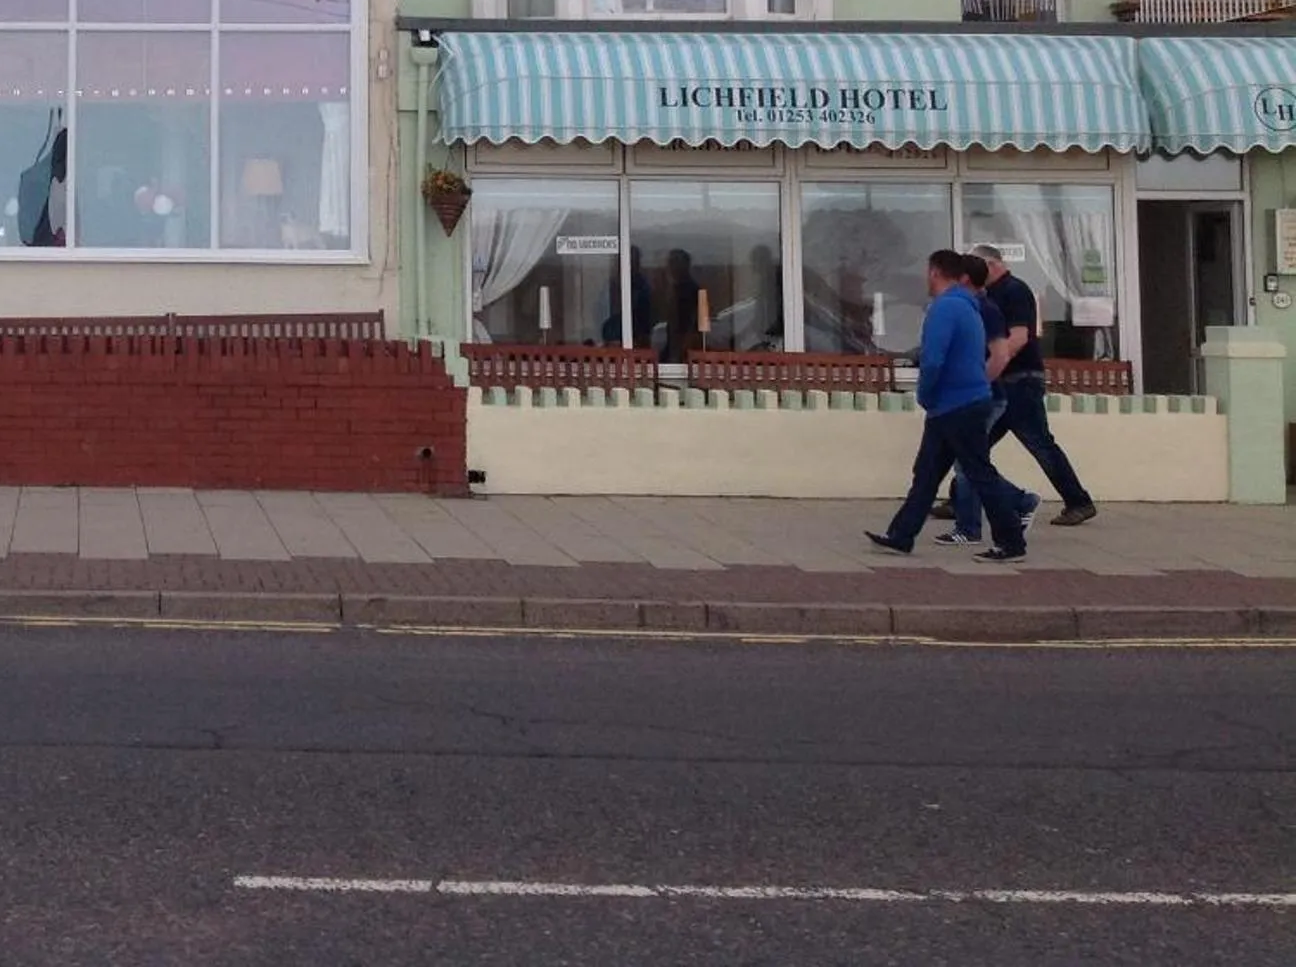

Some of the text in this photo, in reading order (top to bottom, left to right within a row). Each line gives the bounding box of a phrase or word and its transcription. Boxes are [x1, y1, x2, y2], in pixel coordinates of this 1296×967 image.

[659, 87, 948, 111] LICHFIELD HOTEL
[736, 109, 875, 125] Tel. 01253 402326
